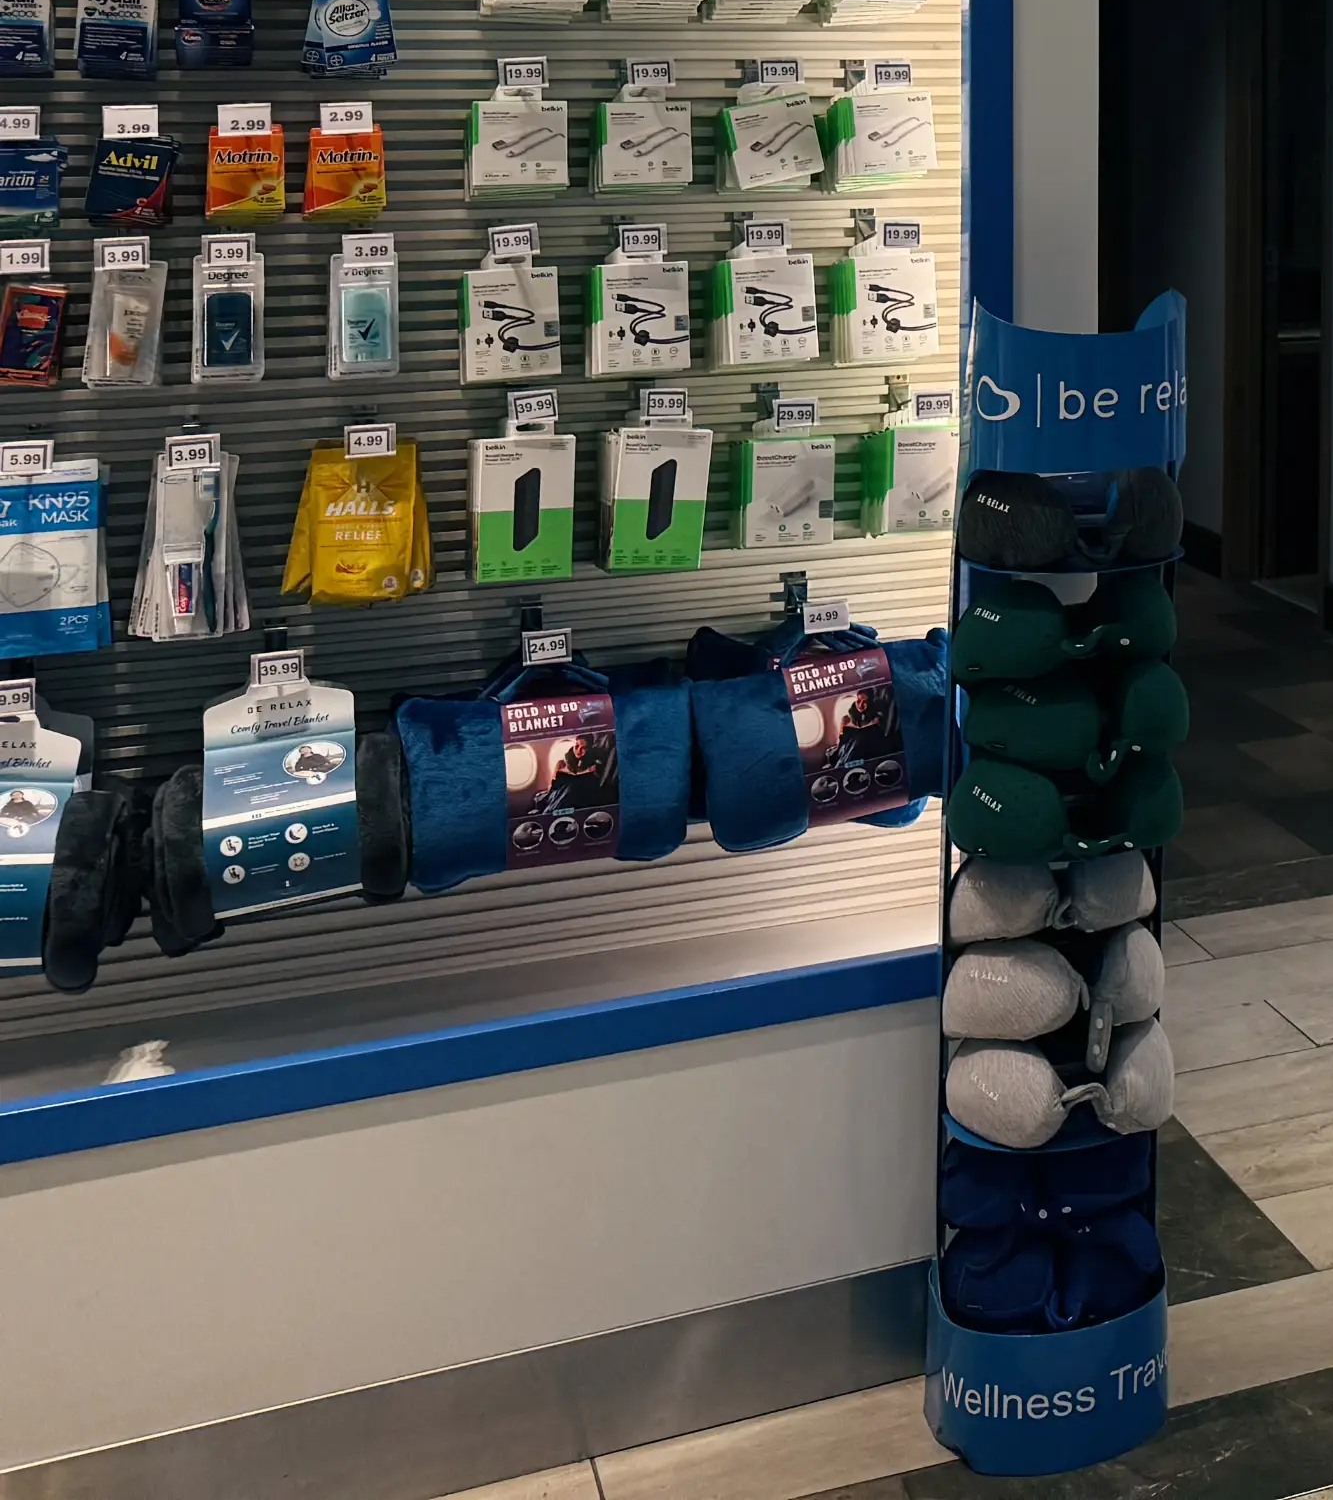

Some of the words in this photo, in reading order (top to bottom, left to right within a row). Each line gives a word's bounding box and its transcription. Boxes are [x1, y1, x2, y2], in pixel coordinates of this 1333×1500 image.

[329, 9, 368, 25] Seltzer
[507, 68, 541, 79] 19.99
[635, 68, 668, 78] 19.99
[764, 67, 796, 77] 19.99
[878, 70, 909, 80] 19.99
[786, 100, 806, 108] belkin
[329, 111, 363, 122] 2.99
[117, 124, 150, 134] 3.99
[230, 120, 266, 130] 2.99
[102, 151, 158, 171] Advil
[215, 149, 273, 164] Motrin
[316, 149, 373, 164] Motrin
[625, 235, 657, 245] 19.99
[749, 230, 781, 240] 19.99
[886, 230, 917, 239] 19.99
[495, 236, 529, 248] 19.99
[107, 251, 140, 263] 3.99
[214, 248, 243, 259] 3.99
[355, 246, 389, 257] 3.99
[6, 253, 40, 264] 1.99
[208, 271, 248, 282] Degree
[650, 399, 683, 408] 39.99
[918, 400, 950, 410] 29.99
[1058, 380, 1119, 420] be
[517, 399, 552, 414] 39.99
[779, 410, 812, 421] 29.99
[354, 436, 383, 447] 4.99
[10, 454, 41, 466] 5.99
[174, 449, 207, 461] 3.99
[28, 491, 90, 510] KN95
[987, 497, 1011, 513] RELAX
[325, 501, 397, 516] HALLS
[41, 510, 89, 524] MASK
[335, 530, 383, 540] RELIEF
[68, 615, 89, 624] PCS
[809, 611, 838, 623] 24.99
[530, 640, 565, 653] 24.99
[260, 661, 299, 677] 39.99
[790, 668, 819, 682] FOLD
[840, 660, 857, 671] GO
[794, 673, 844, 694] BLANKET
[270, 699, 313, 711] RELAX
[508, 706, 539, 719] FOLD
[561, 702, 578, 712] GO
[230, 724, 261, 735] Comfy
[264, 717, 293, 729] Travel
[294, 714, 330, 726] Blanket
[509, 715, 564, 733] BLANKET
[981, 792, 1003, 813] RELAX
[942, 1366, 1097, 1421] Wellness
